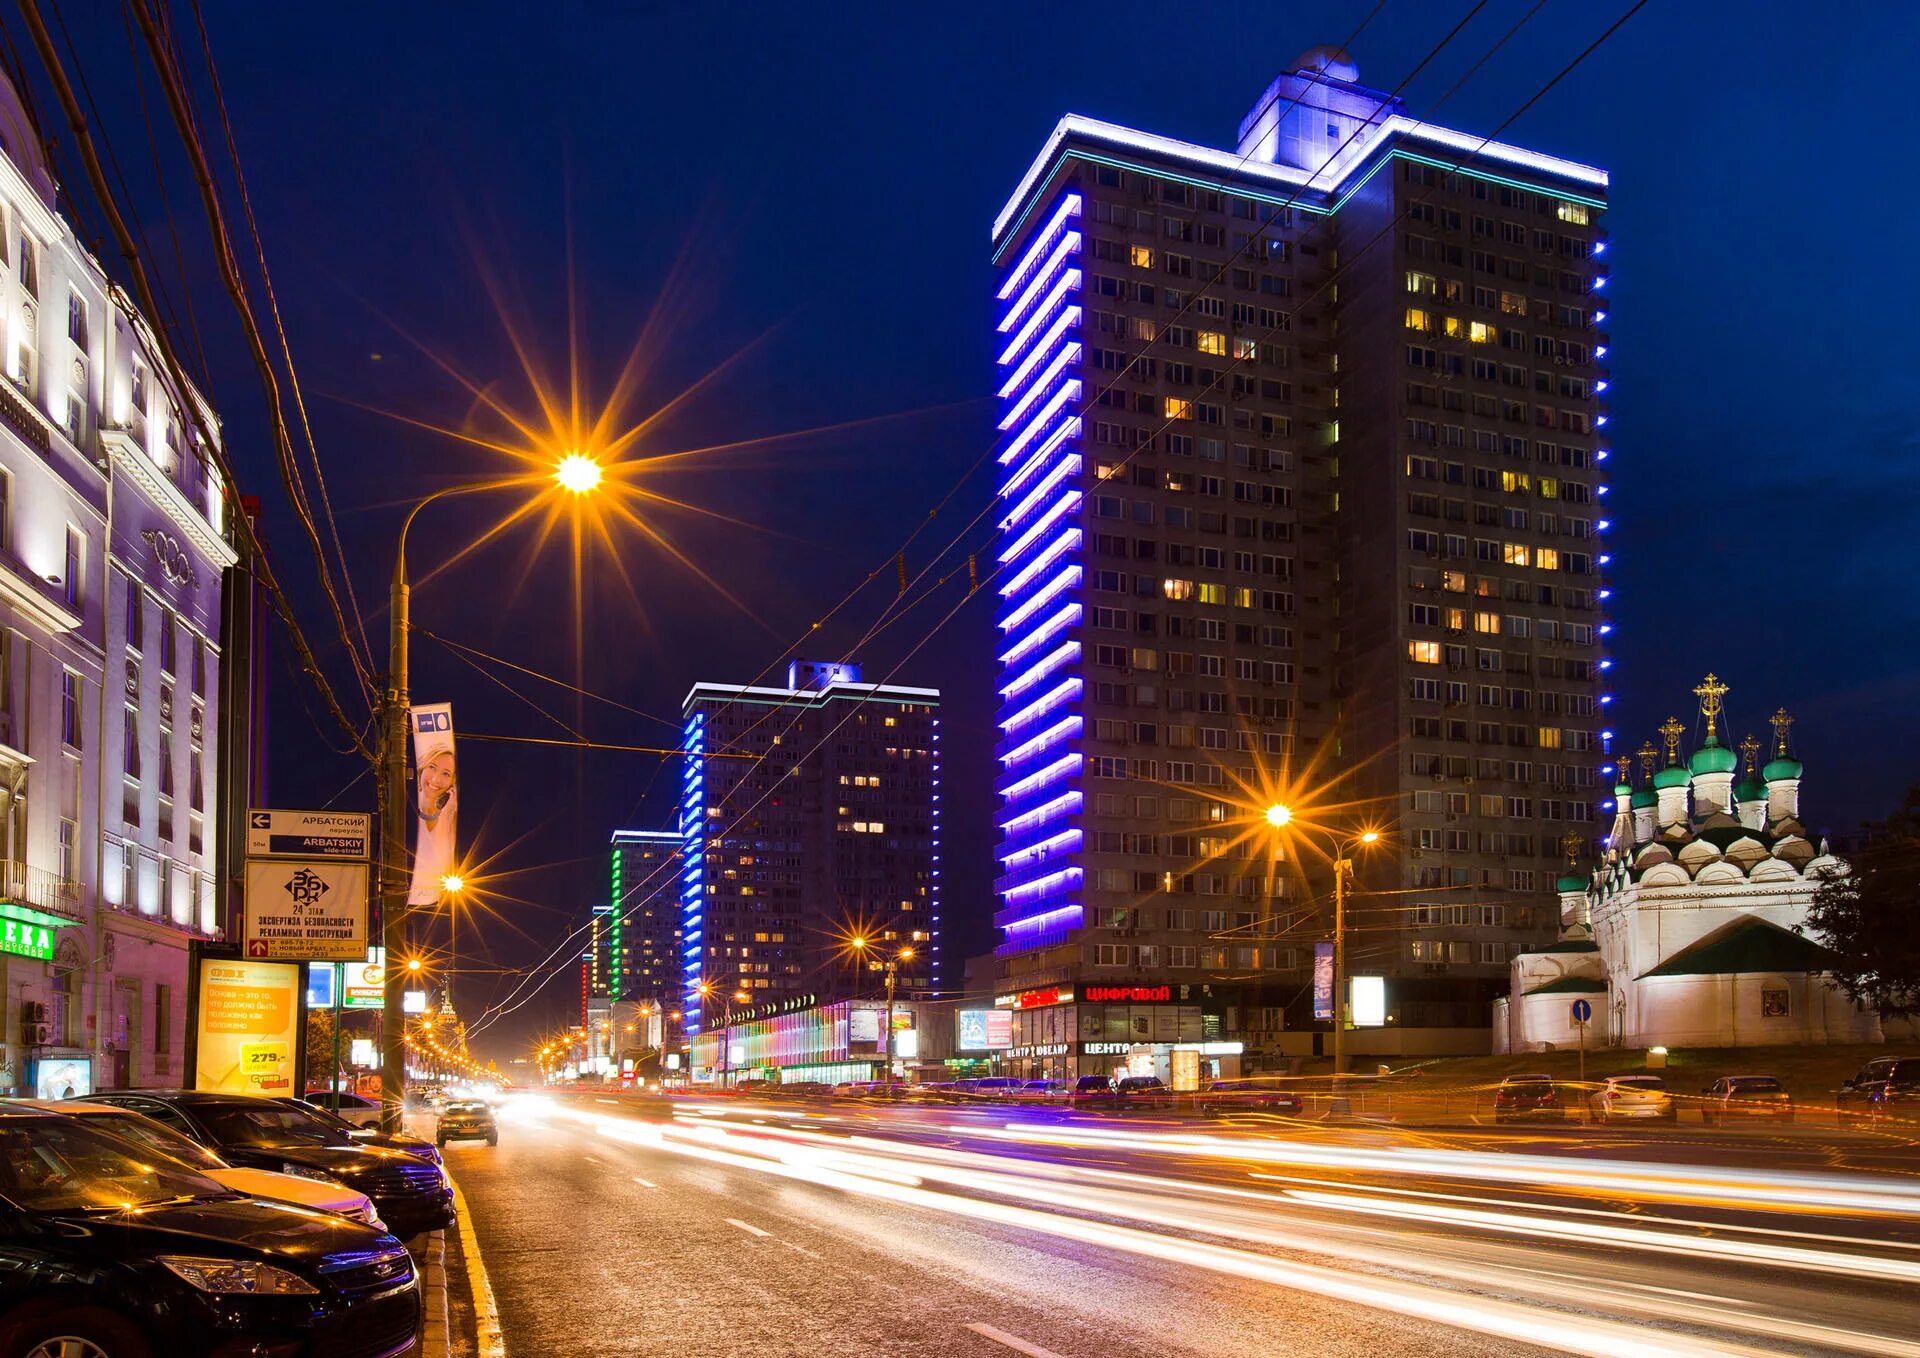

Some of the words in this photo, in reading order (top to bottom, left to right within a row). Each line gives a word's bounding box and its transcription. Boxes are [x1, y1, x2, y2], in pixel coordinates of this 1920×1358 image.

[302, 817, 365, 826] АРБАТСКИЙ
[329, 827, 363, 835] переулок
[303, 838, 362, 848] ARBATSKIY
[293, 905, 303, 915] 24
[258, 916, 301, 926] ЭКСПЕРТИЗА
[304, 918, 354, 927] БЕЗОПАСНОСТИ
[259, 927, 303, 938] РЕКЛАМНЫХ
[306, 928, 353, 939] КОНСТРУКЦИЙ
[1319, 956, 1333, 999] GPON
[208, 989, 237, 998] Основа
[246, 991, 260, 999] это
[1086, 985, 1170, 1001] ЦИФРОВОЙ
[223, 1001, 255, 1009] должно
[256, 1002, 277, 1010] быть
[208, 1011, 247, 1019] положено
[1006, 1047, 1030, 1059] ЦЕНТР
[1036, 1044, 1069, 1056] ЮВЕЛИР
[251, 1074, 280, 1084] Супер
